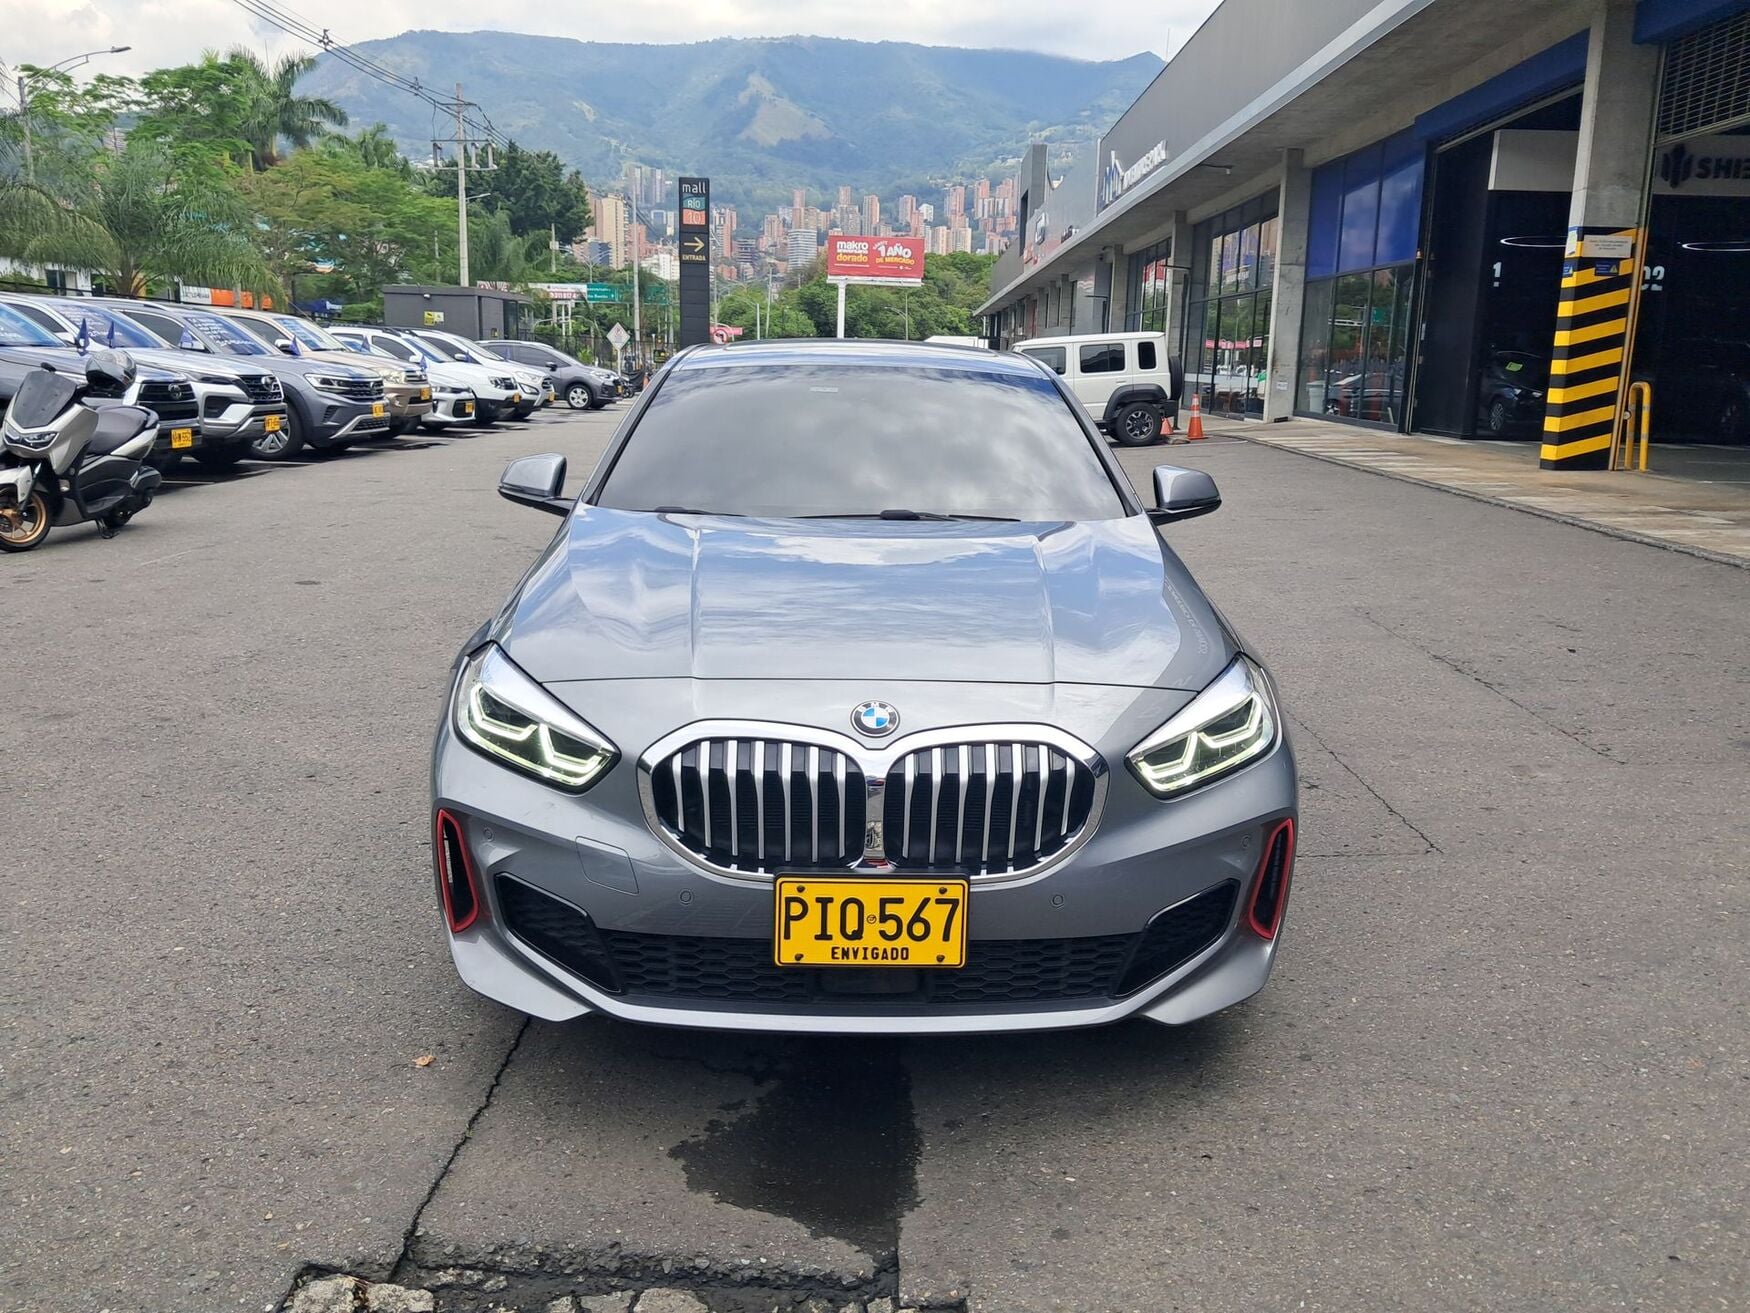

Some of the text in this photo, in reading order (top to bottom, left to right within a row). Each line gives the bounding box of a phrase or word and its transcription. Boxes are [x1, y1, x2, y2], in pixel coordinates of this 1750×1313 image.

[682, 182, 706, 194] mall
[836, 241, 869, 250] makro
[886, 243, 912, 258] AÑO
[836, 253, 868, 263] dorado
[885, 256, 915, 265] MERCADO
[831, 946, 909, 961] ENVIGADO
